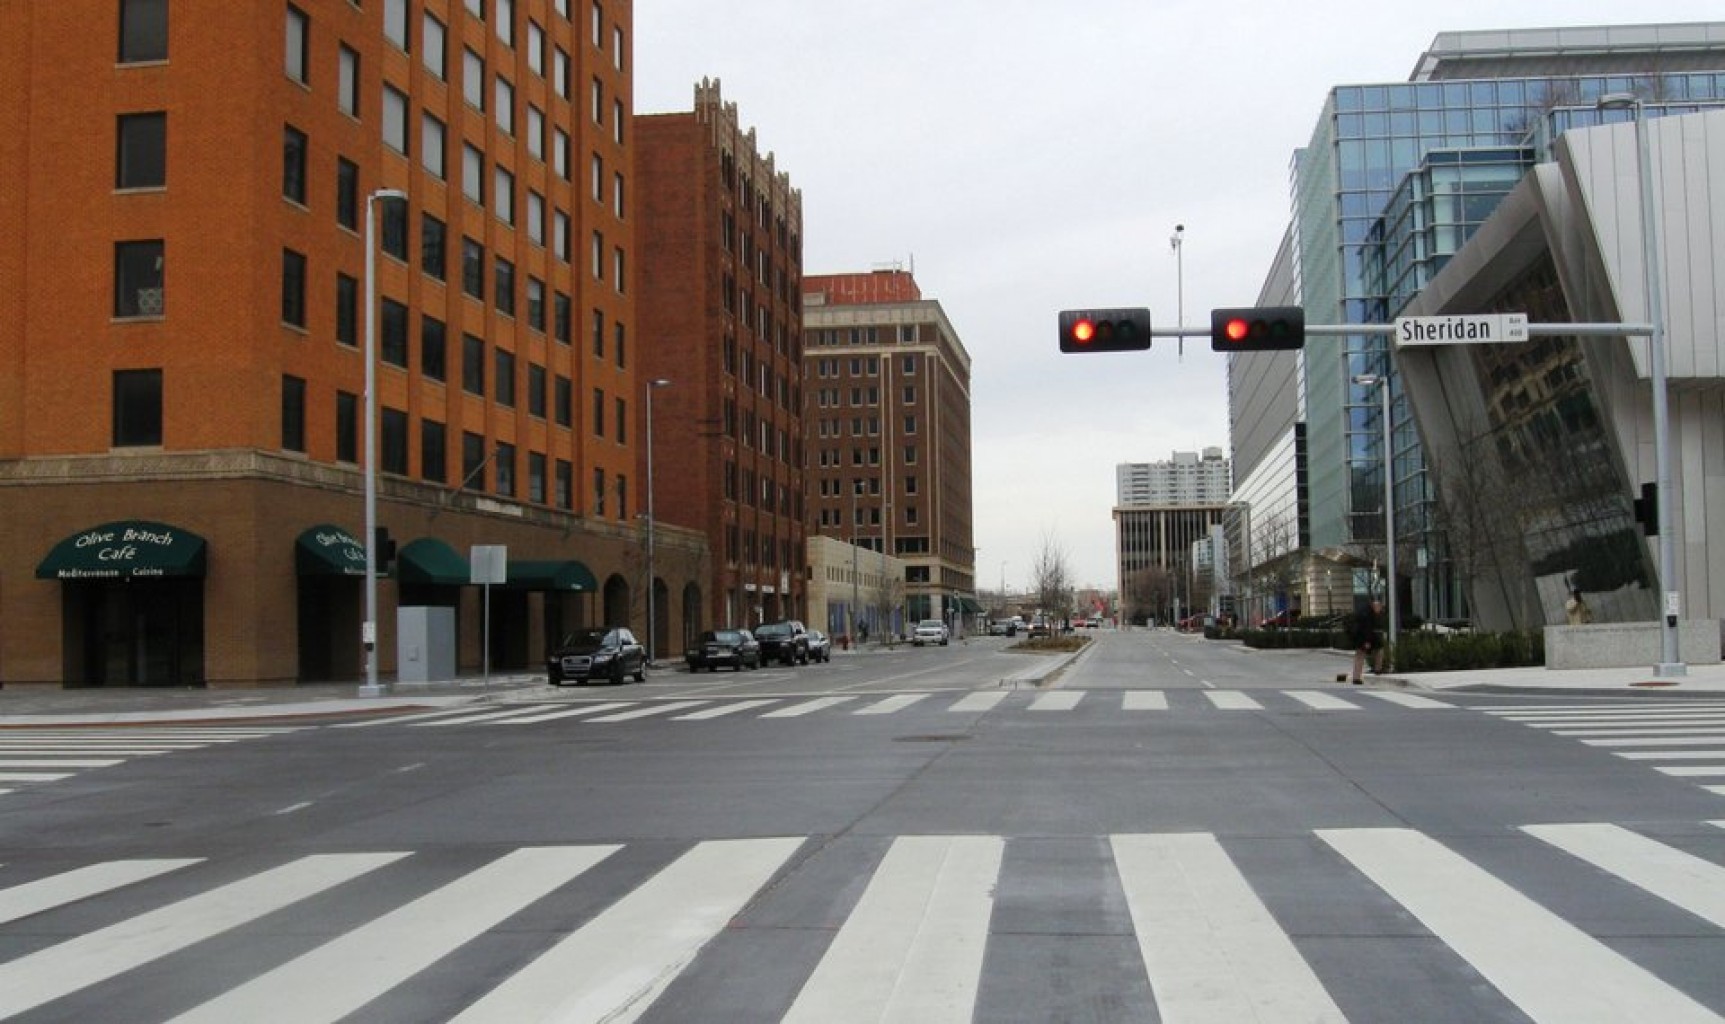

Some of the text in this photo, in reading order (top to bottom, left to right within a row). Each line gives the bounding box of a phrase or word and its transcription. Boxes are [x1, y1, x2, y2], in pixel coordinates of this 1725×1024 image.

[1402, 317, 1491, 341] Sheridan
[75, 527, 174, 548] Olive Branch
[98, 544, 138, 561] Café
